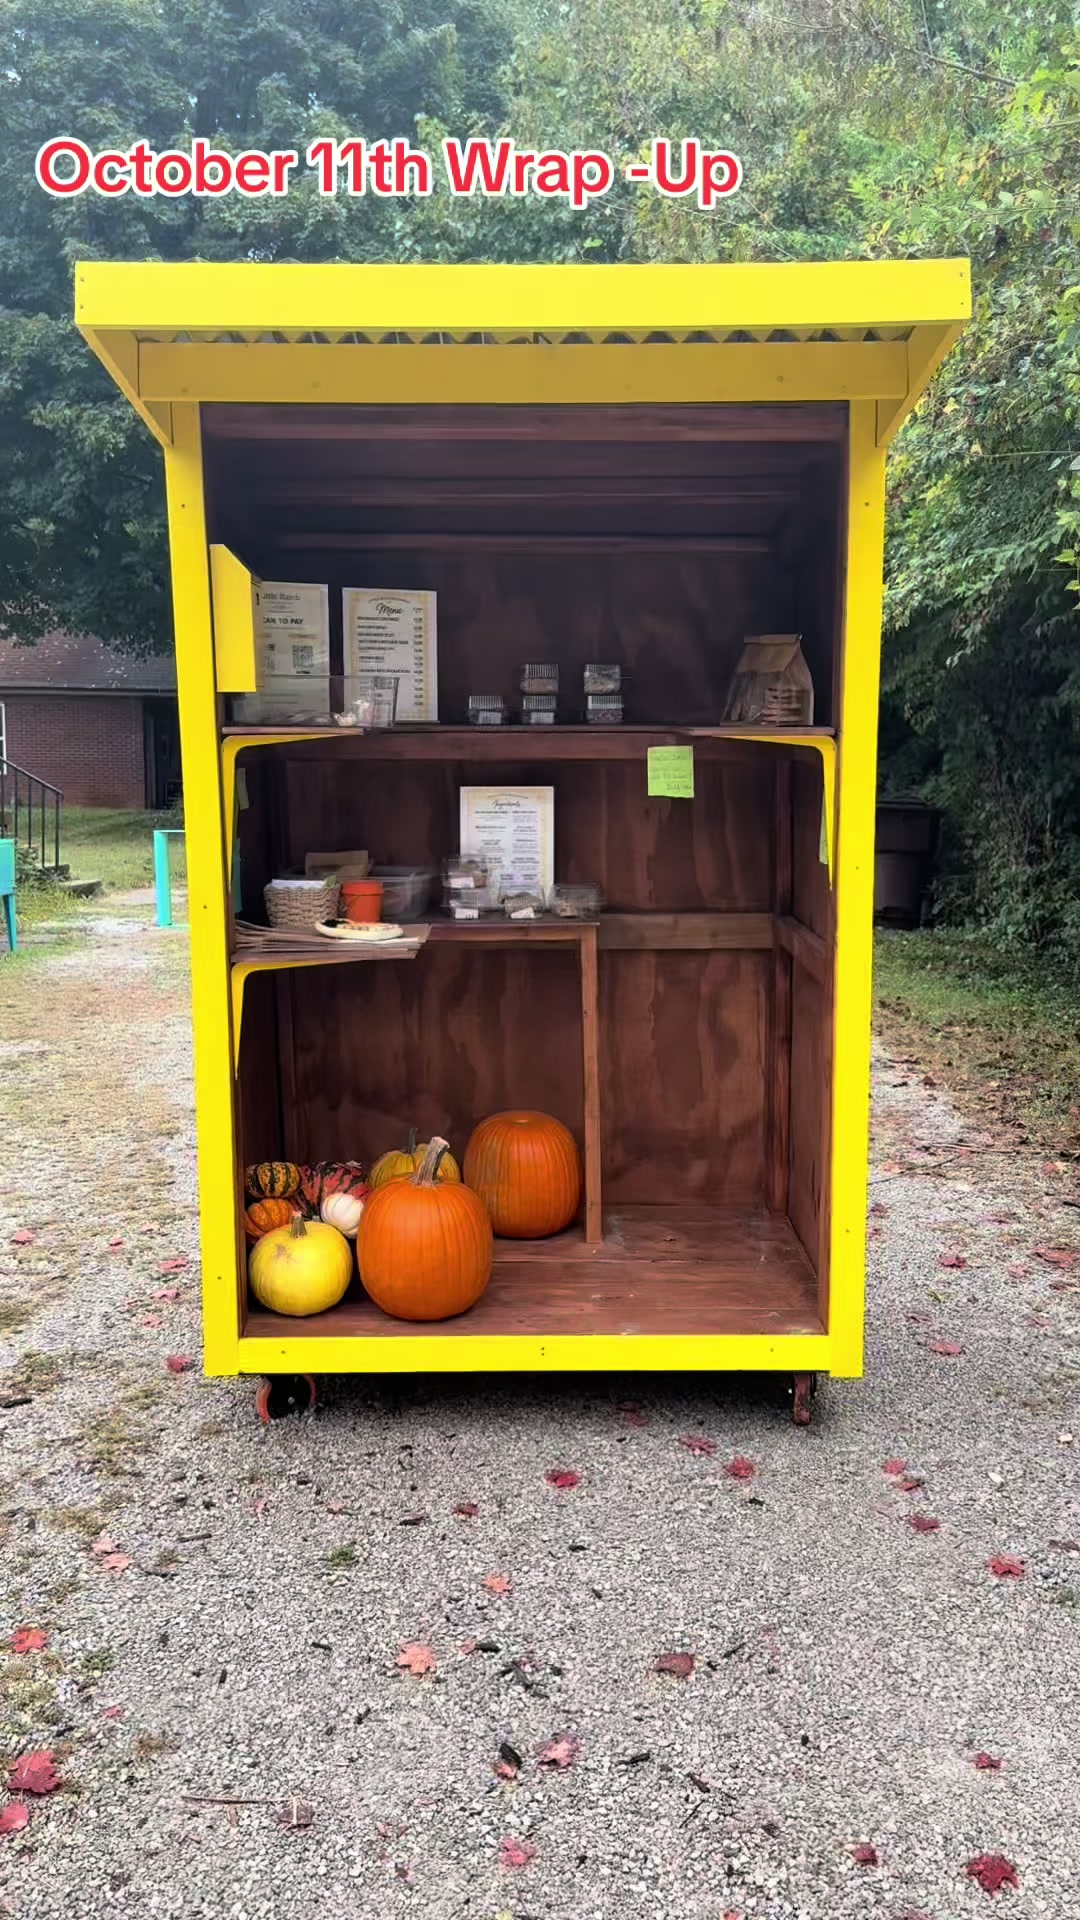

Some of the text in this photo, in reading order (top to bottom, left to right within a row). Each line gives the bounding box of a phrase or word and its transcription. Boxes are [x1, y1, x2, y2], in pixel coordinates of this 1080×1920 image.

[376, 602, 403, 616] Menu
[263, 616, 277, 624] CAN
[279, 617, 289, 625] TO
